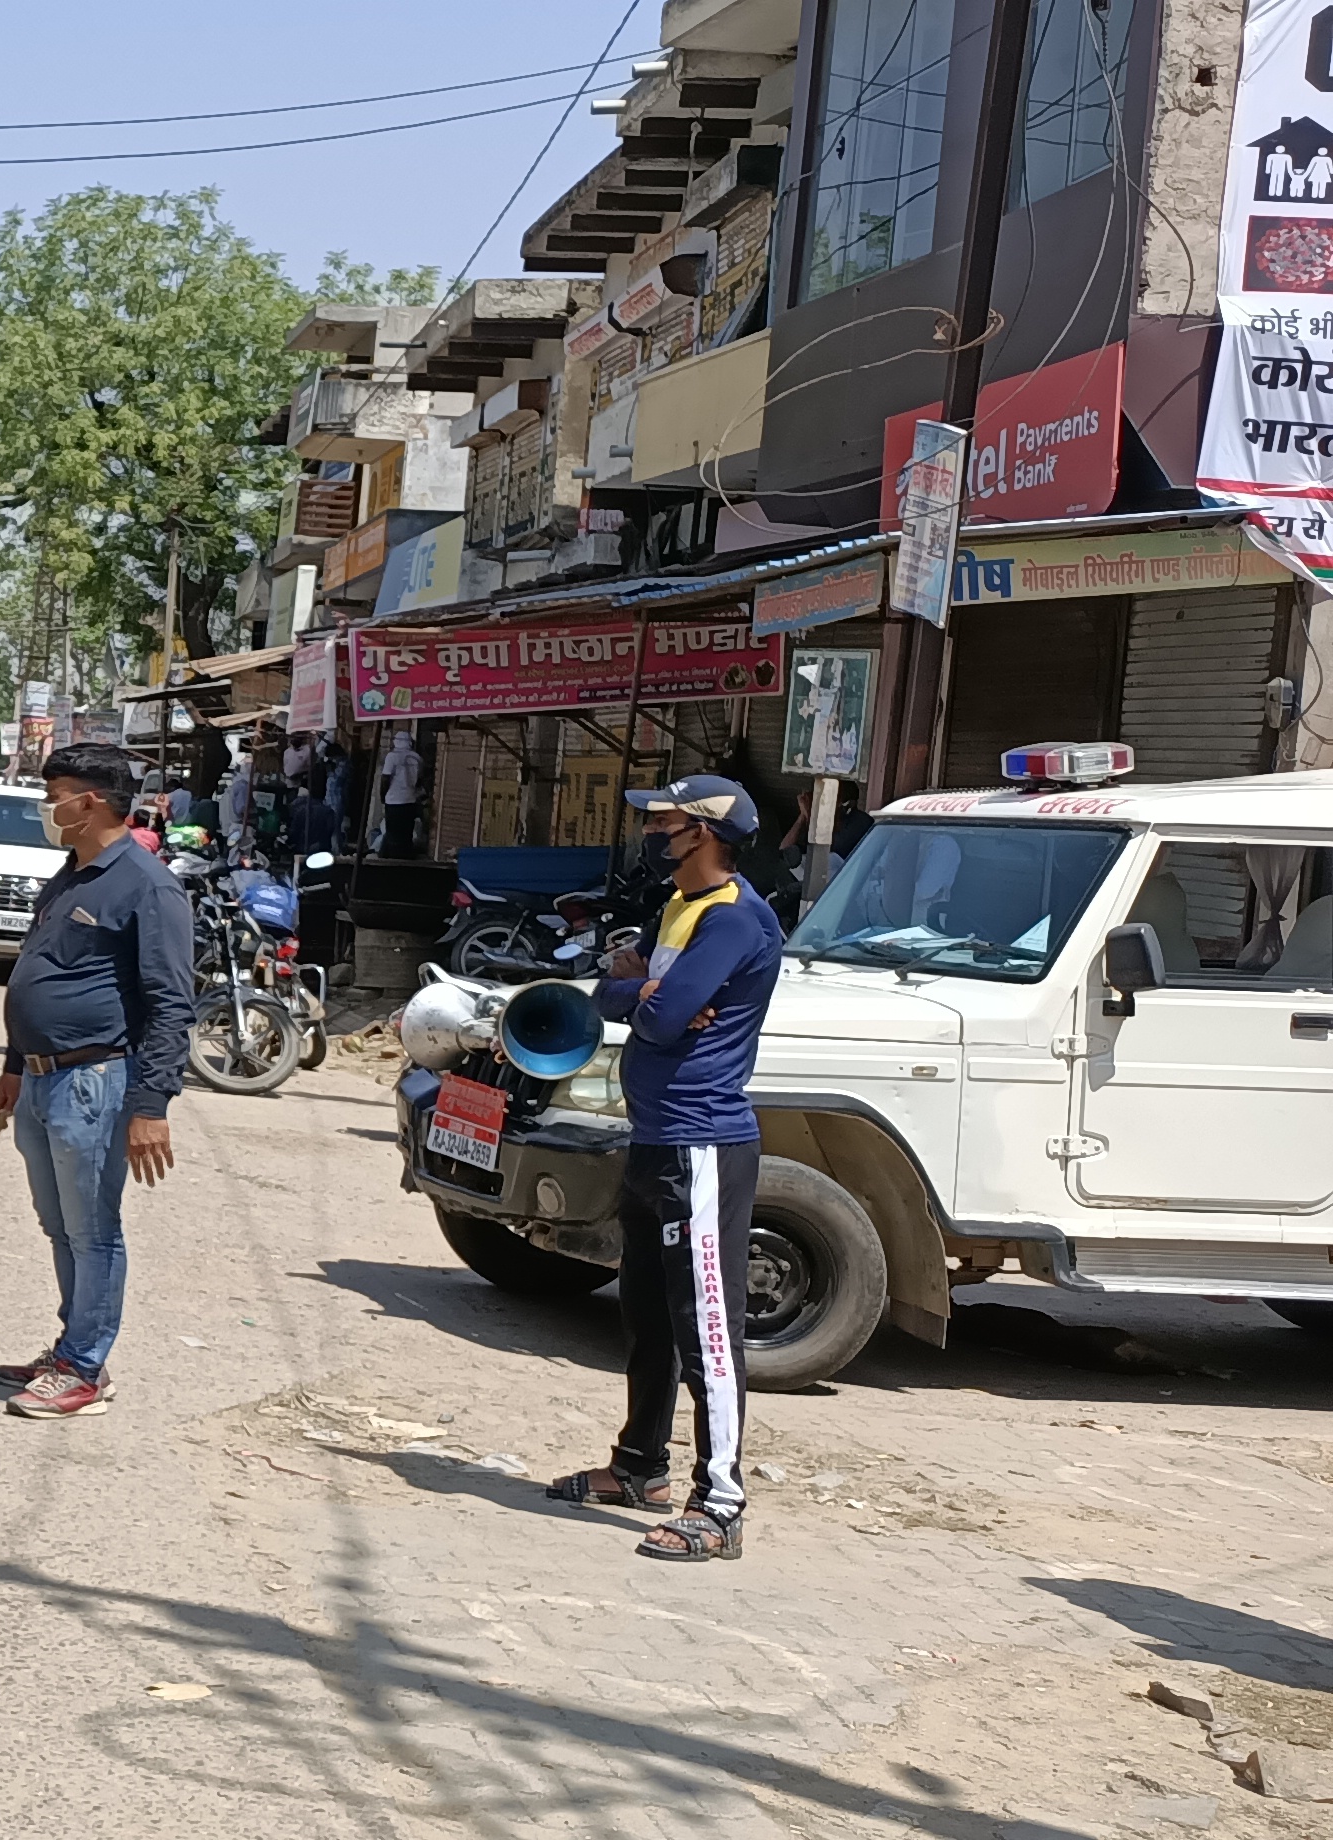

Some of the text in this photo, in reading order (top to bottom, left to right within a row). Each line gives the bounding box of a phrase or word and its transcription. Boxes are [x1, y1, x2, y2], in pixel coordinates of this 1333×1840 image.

[1251, 308, 1302, 340] कोई
[967, 427, 1007, 501] tel
[1015, 406, 1099, 457] Payments
[1014, 452, 1057, 491] Bank
[1301, 511, 1326, 541] से
[1021, 559, 1080, 593] मोबाइल
[1150, 557, 1181, 583] एण्ड
[434, 640, 511, 682] कृपा
[654, 623, 768, 655] भण्डार
[706, 1310, 727, 1378] SPORTS
